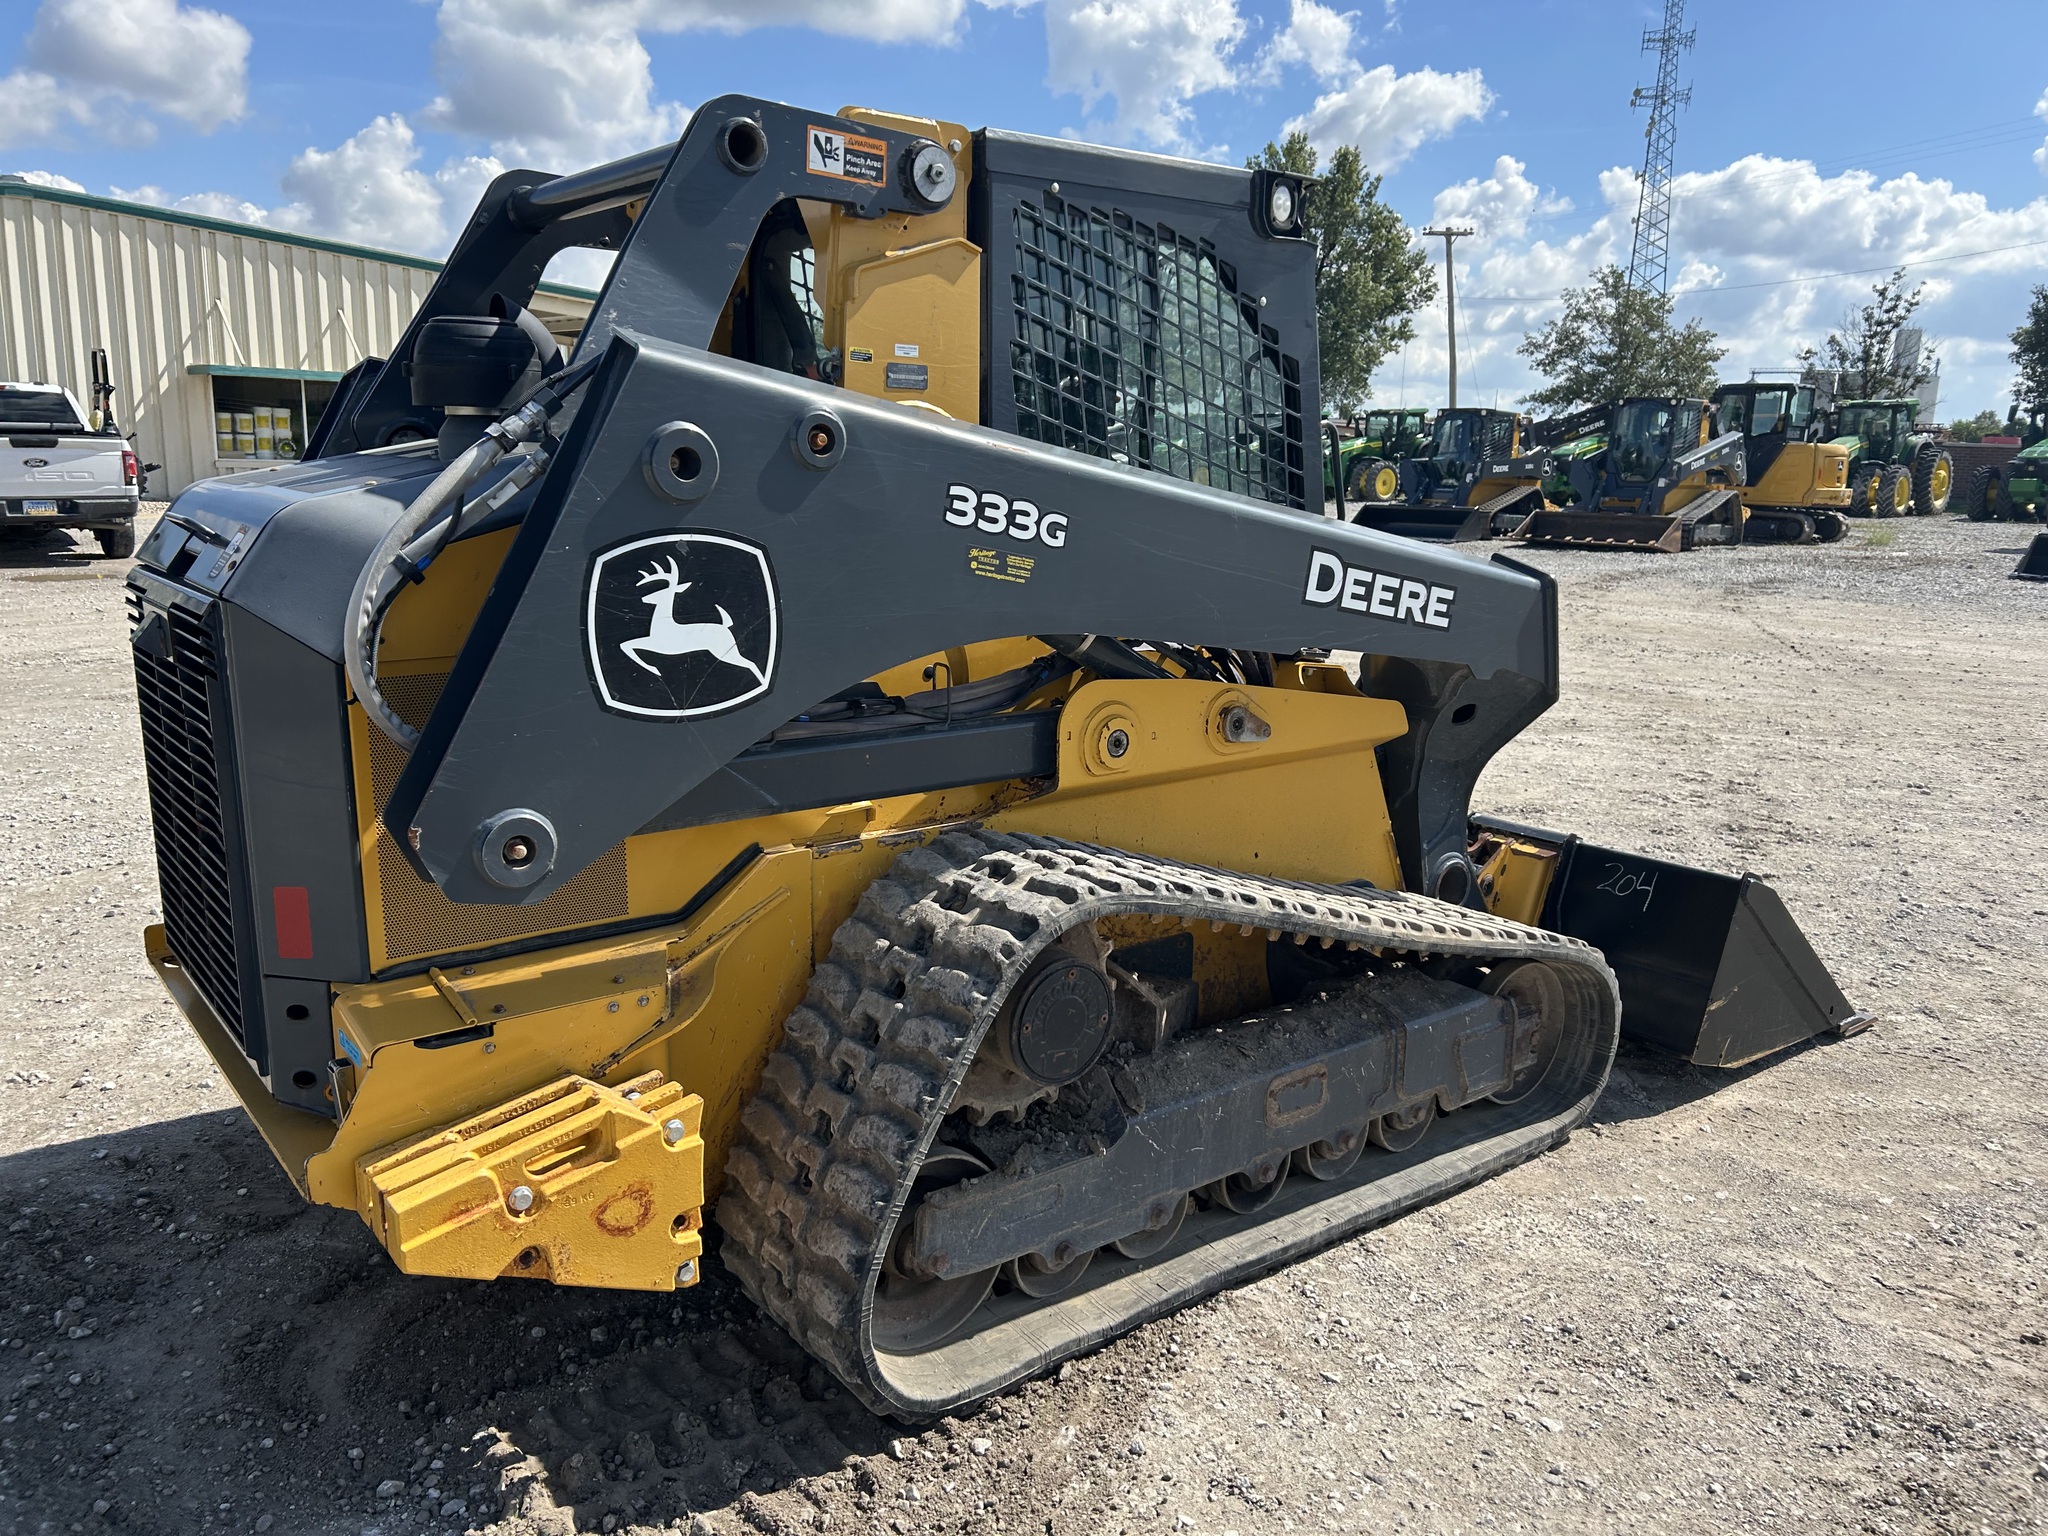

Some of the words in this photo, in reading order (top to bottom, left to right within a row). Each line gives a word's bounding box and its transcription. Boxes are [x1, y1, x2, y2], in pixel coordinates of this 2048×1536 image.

[854, 139, 883, 150] WARNING
[846, 154, 865, 165] Pinch
[866, 159, 881, 168] Area
[845, 164, 860, 174] Keep
[861, 169, 877, 177] Away
[1579, 420, 1606, 435] DEERE
[1492, 464, 1510, 474] DEERE
[1690, 457, 1706, 470] DEERE
[945, 485, 1068, 548] 333G
[968, 548, 997, 558] Heritage
[1305, 550, 1455, 628] DEERE
[1596, 862, 1659, 912] 204
[464, 1123, 484, 1136] USA
[480, 1141, 501, 1154] USA
[497, 1157, 517, 1171] USA
